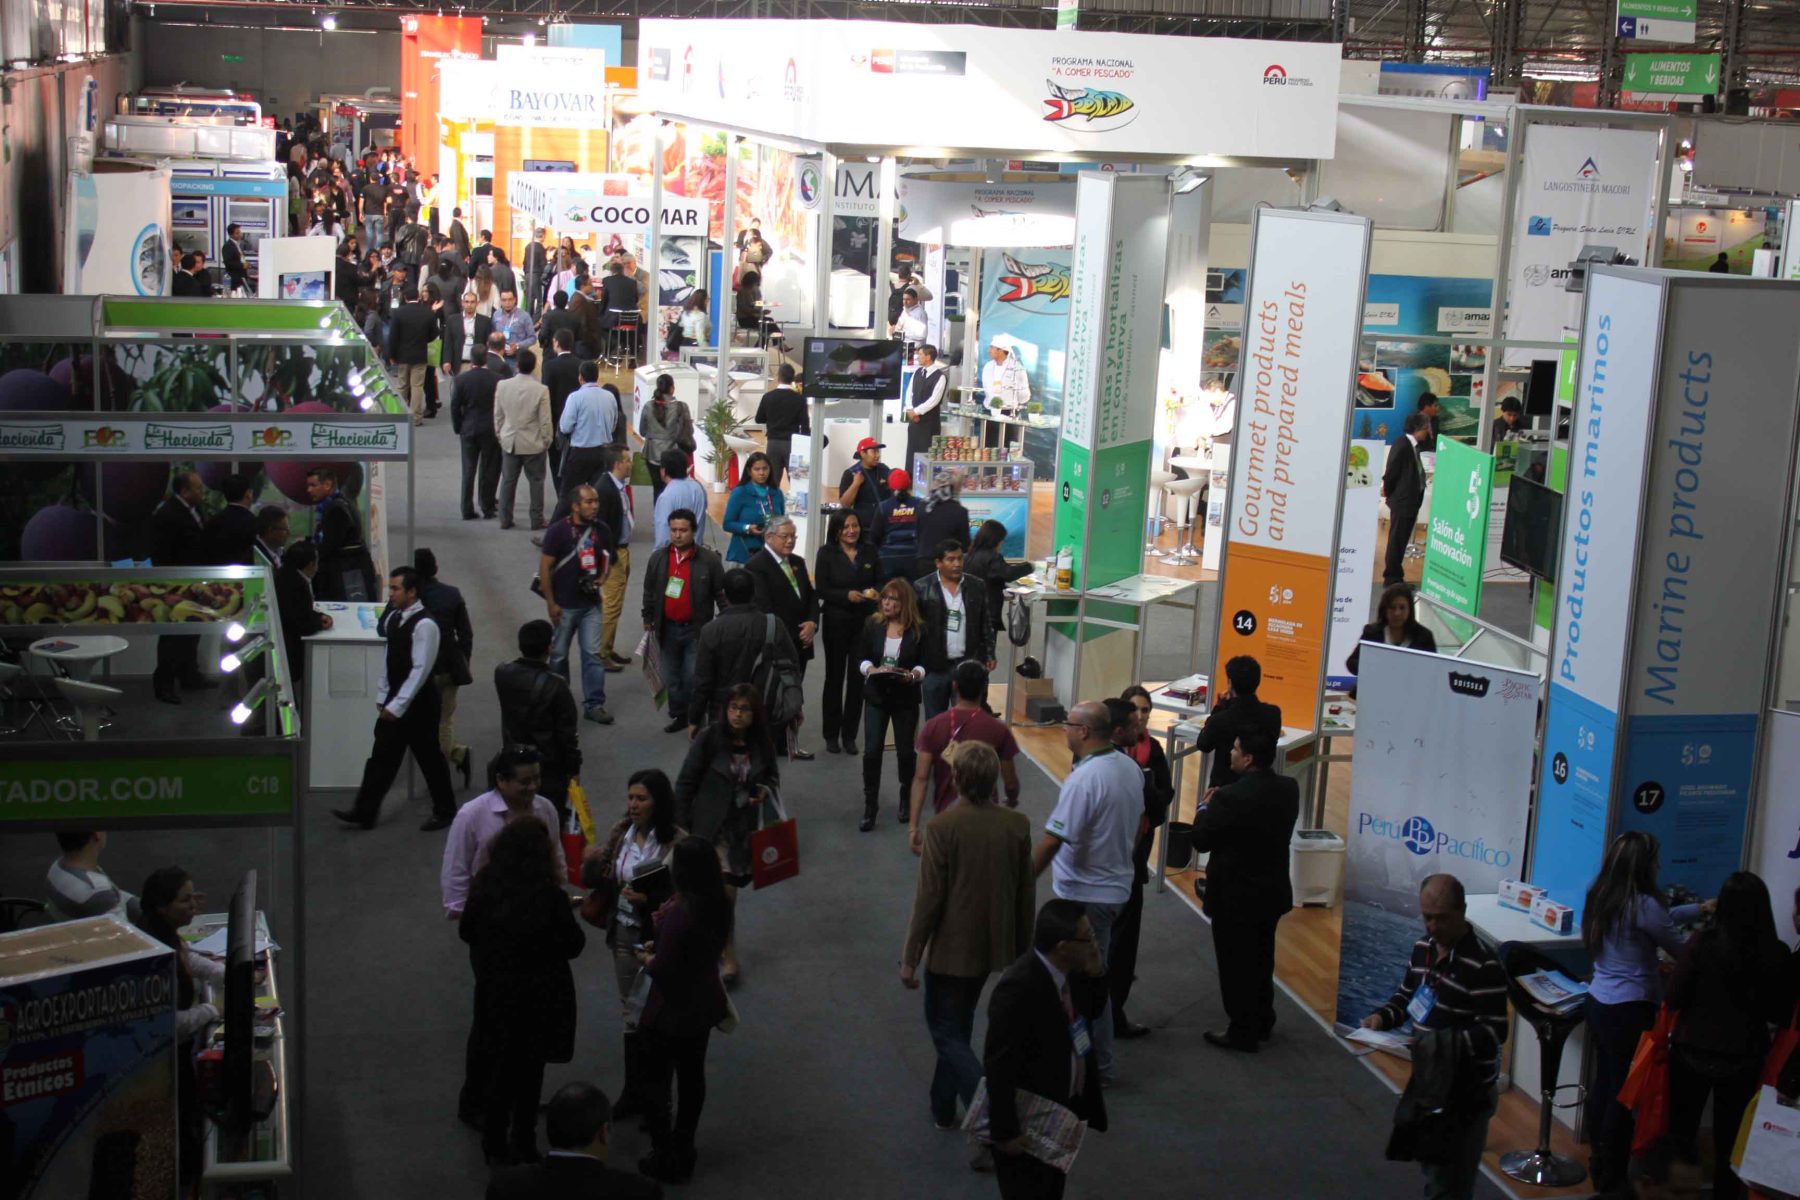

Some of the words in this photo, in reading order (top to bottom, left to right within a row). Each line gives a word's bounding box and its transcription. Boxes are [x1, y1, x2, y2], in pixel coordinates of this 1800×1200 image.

[1052, 57, 1093, 66] PROGRAMA
[1096, 59, 1134, 68] NACIONAL
[1065, 68, 1091, 77] COMER
[1649, 61, 1692, 73] ALIMENTOS
[1649, 75, 1654, 85] Y
[1654, 75, 1686, 86] BEBIDAS
[1105, 239, 1123, 350] hortalizas
[1284, 280, 1307, 359] meals
[1076, 310, 1088, 405] conserva
[1113, 313, 1128, 408] conserva
[1253, 300, 1279, 416] products
[1065, 369, 1077, 436] Frutas
[1099, 375, 1113, 444] Frutas
[162, 429, 225, 448] Hacienda
[328, 429, 388, 447] Hacienda
[1110, 416, 1119, 442] en
[1273, 364, 1299, 487] prepared
[1239, 421, 1268, 537] Gourmet
[1560, 490, 1594, 682] Productos
[1583, 315, 1612, 479] marinos
[1266, 488, 1289, 542] and
[1644, 551, 1691, 705] Marine
[1669, 351, 1713, 540] products
[1432, 517, 1454, 540] Salón
[1454, 528, 1465, 545] de
[1430, 534, 1473, 568] Innovación
[1236, 616, 1253, 631] 14
[1555, 759, 1566, 779] 16
[247, 776, 280, 795] C18
[1638, 789, 1661, 807] 17
[1358, 812, 1400, 841] Perú
[3, 1056, 74, 1082] Productos
